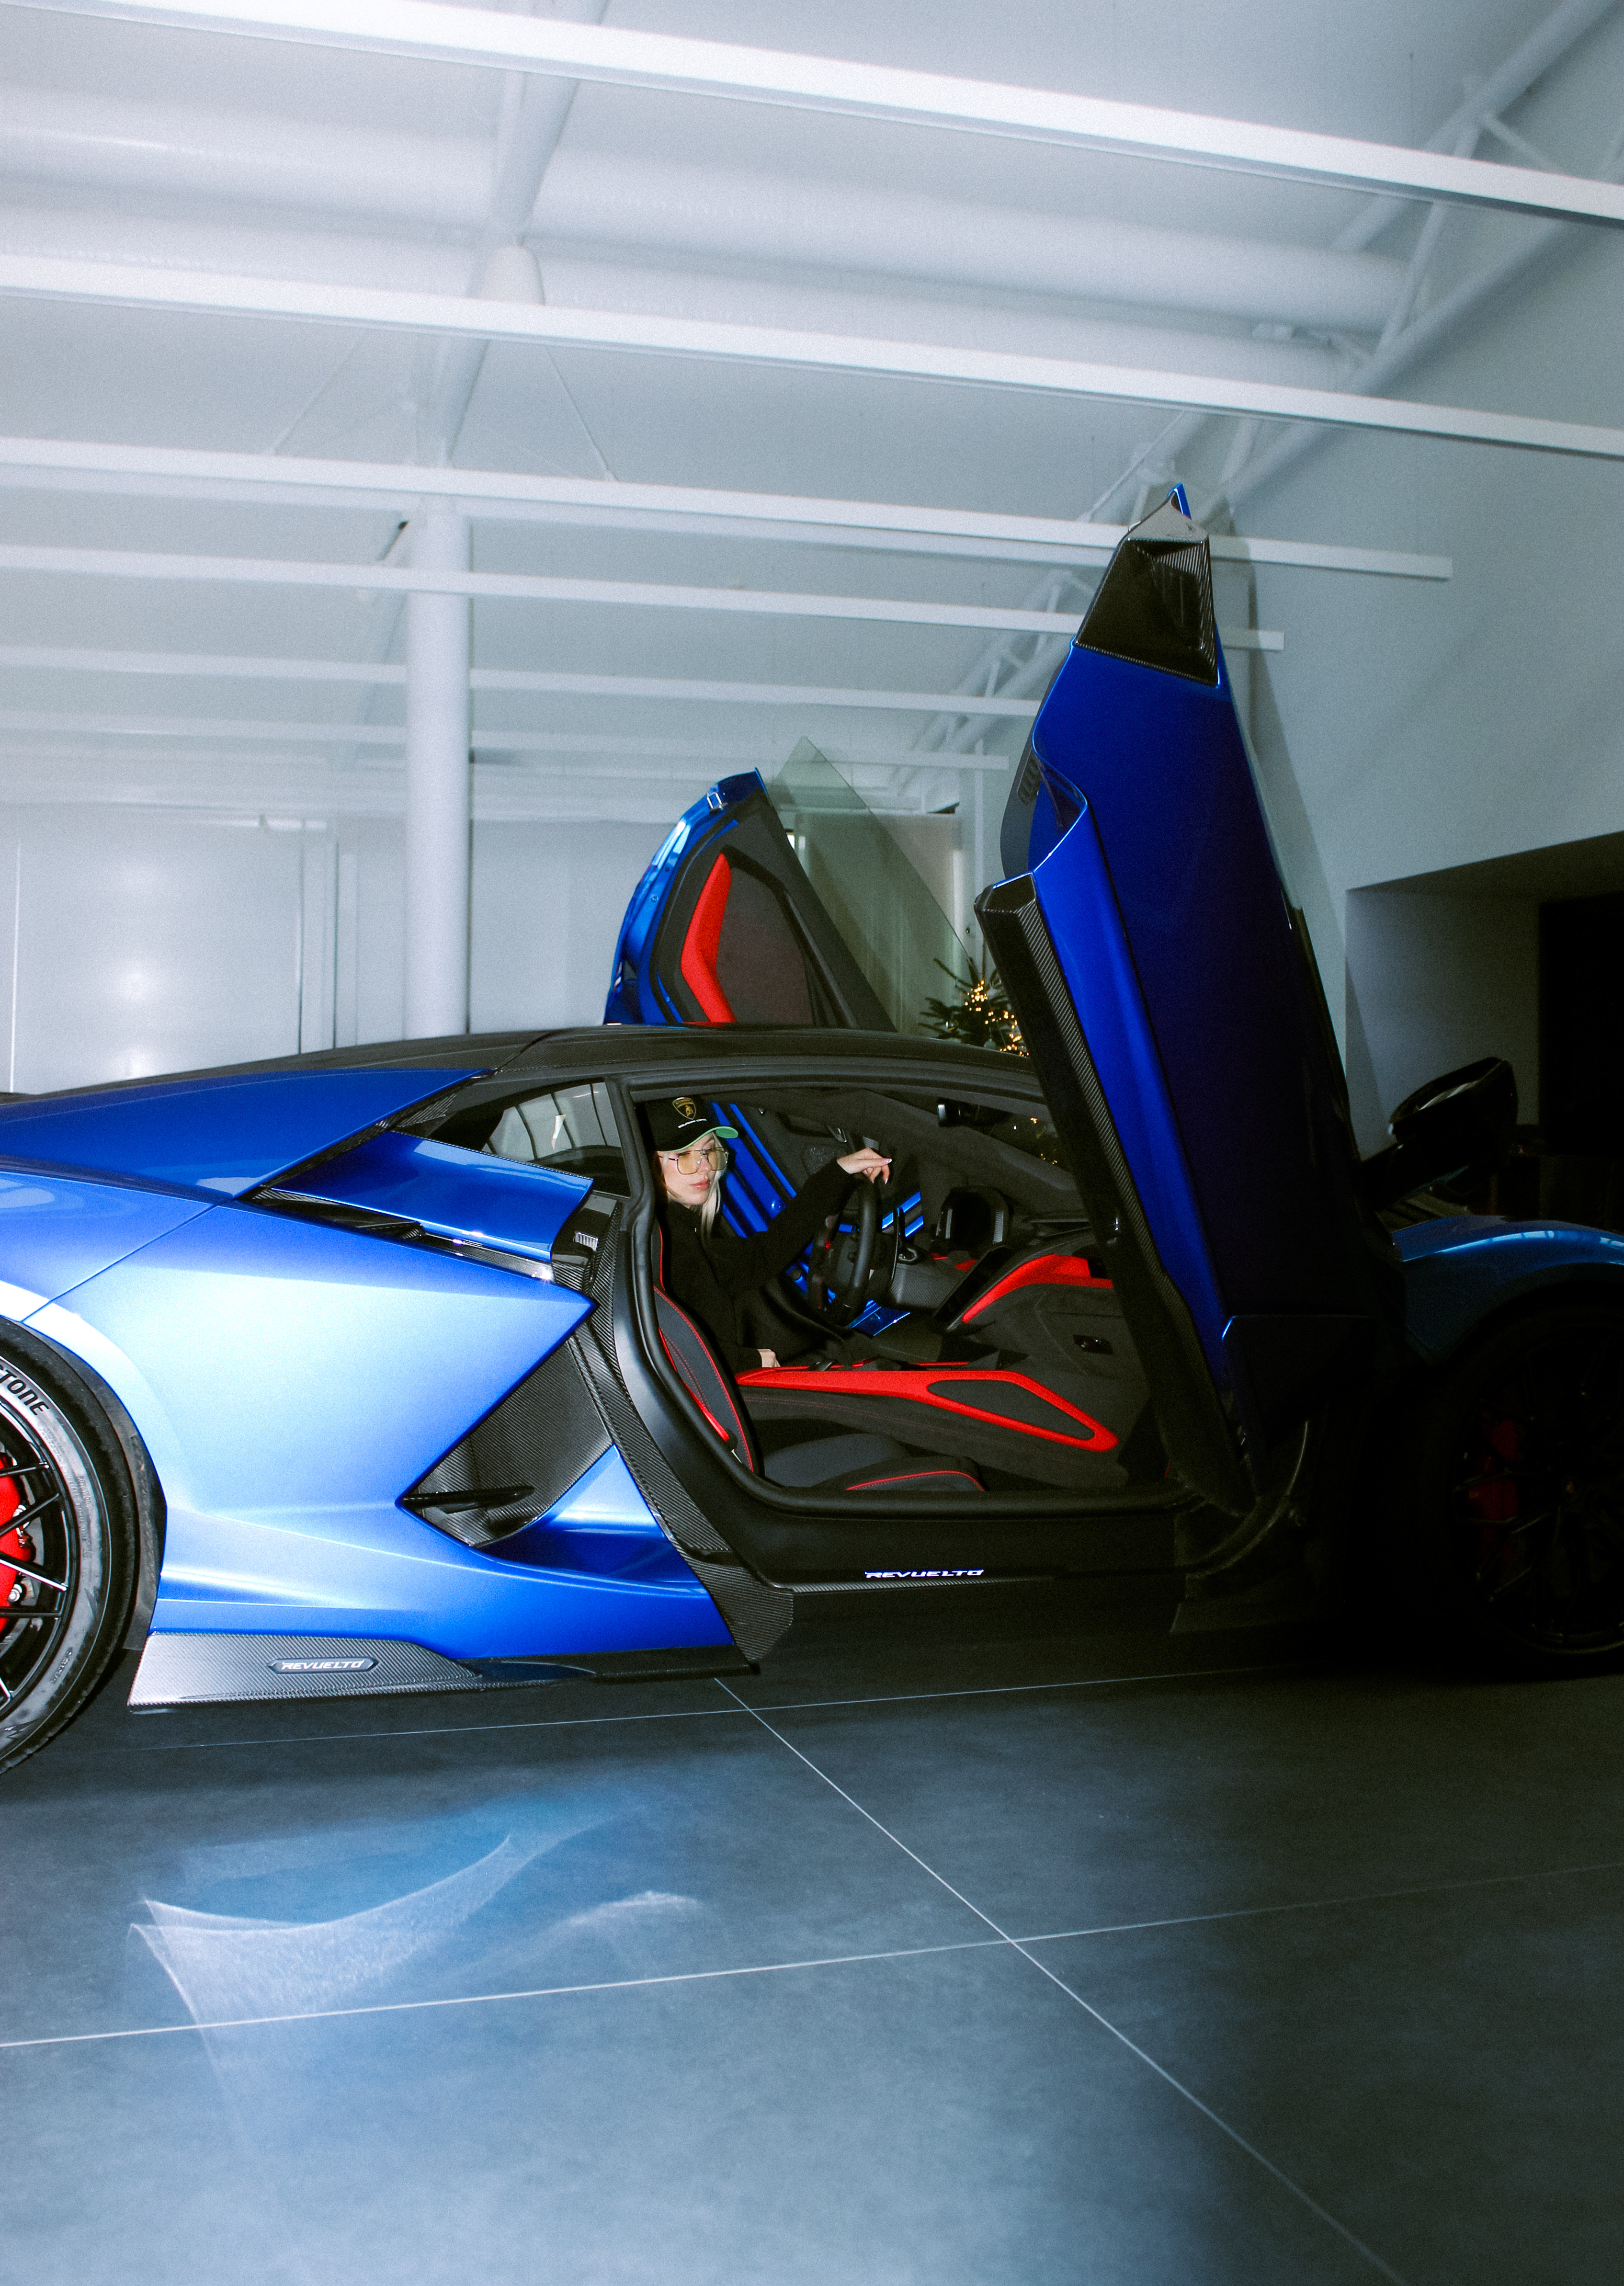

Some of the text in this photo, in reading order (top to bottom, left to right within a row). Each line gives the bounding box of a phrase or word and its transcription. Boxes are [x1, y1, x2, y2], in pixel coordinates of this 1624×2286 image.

[0, 1365, 49, 1415] TONE
[864, 1569, 984, 1578] REVUELTO
[281, 1659, 365, 1670] REVUELTO
